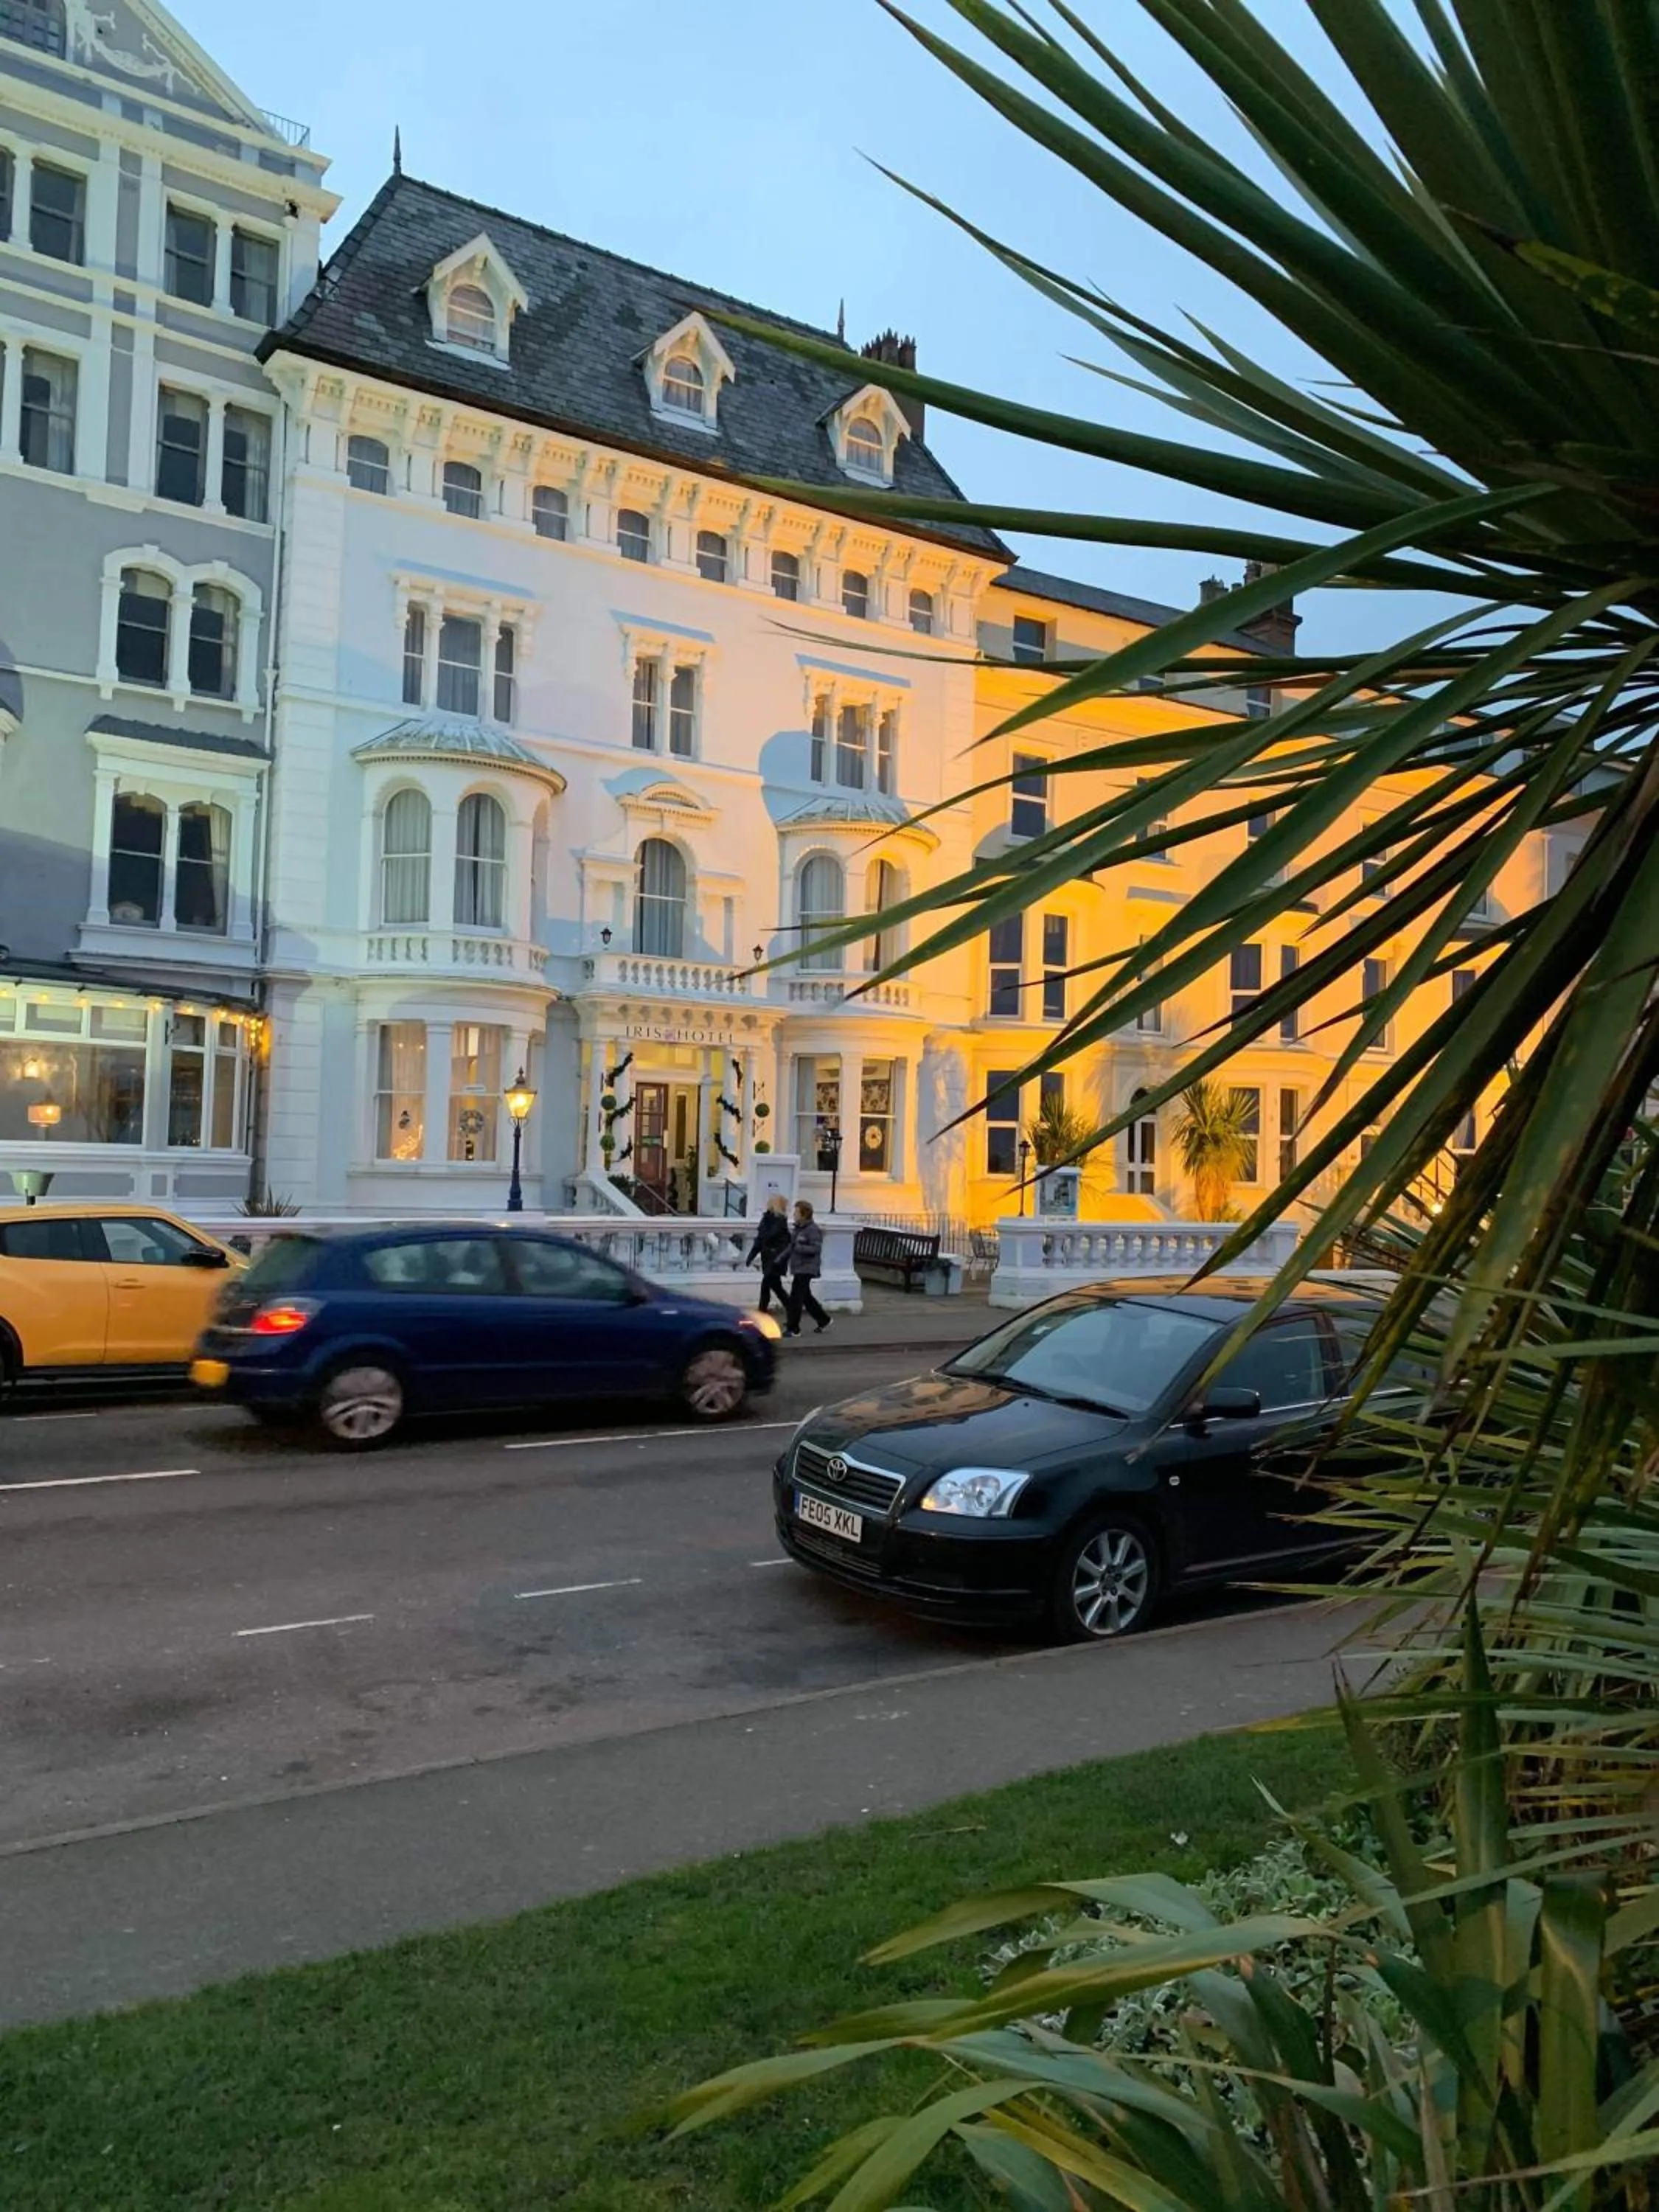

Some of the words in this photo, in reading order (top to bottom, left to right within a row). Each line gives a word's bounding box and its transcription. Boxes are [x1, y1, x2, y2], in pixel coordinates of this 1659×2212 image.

[626, 1026, 661, 1039] IRIS
[678, 1029, 734, 1044] HOTEL
[801, 1496, 831, 1526] FE05
[834, 1509, 859, 1537] XKL
